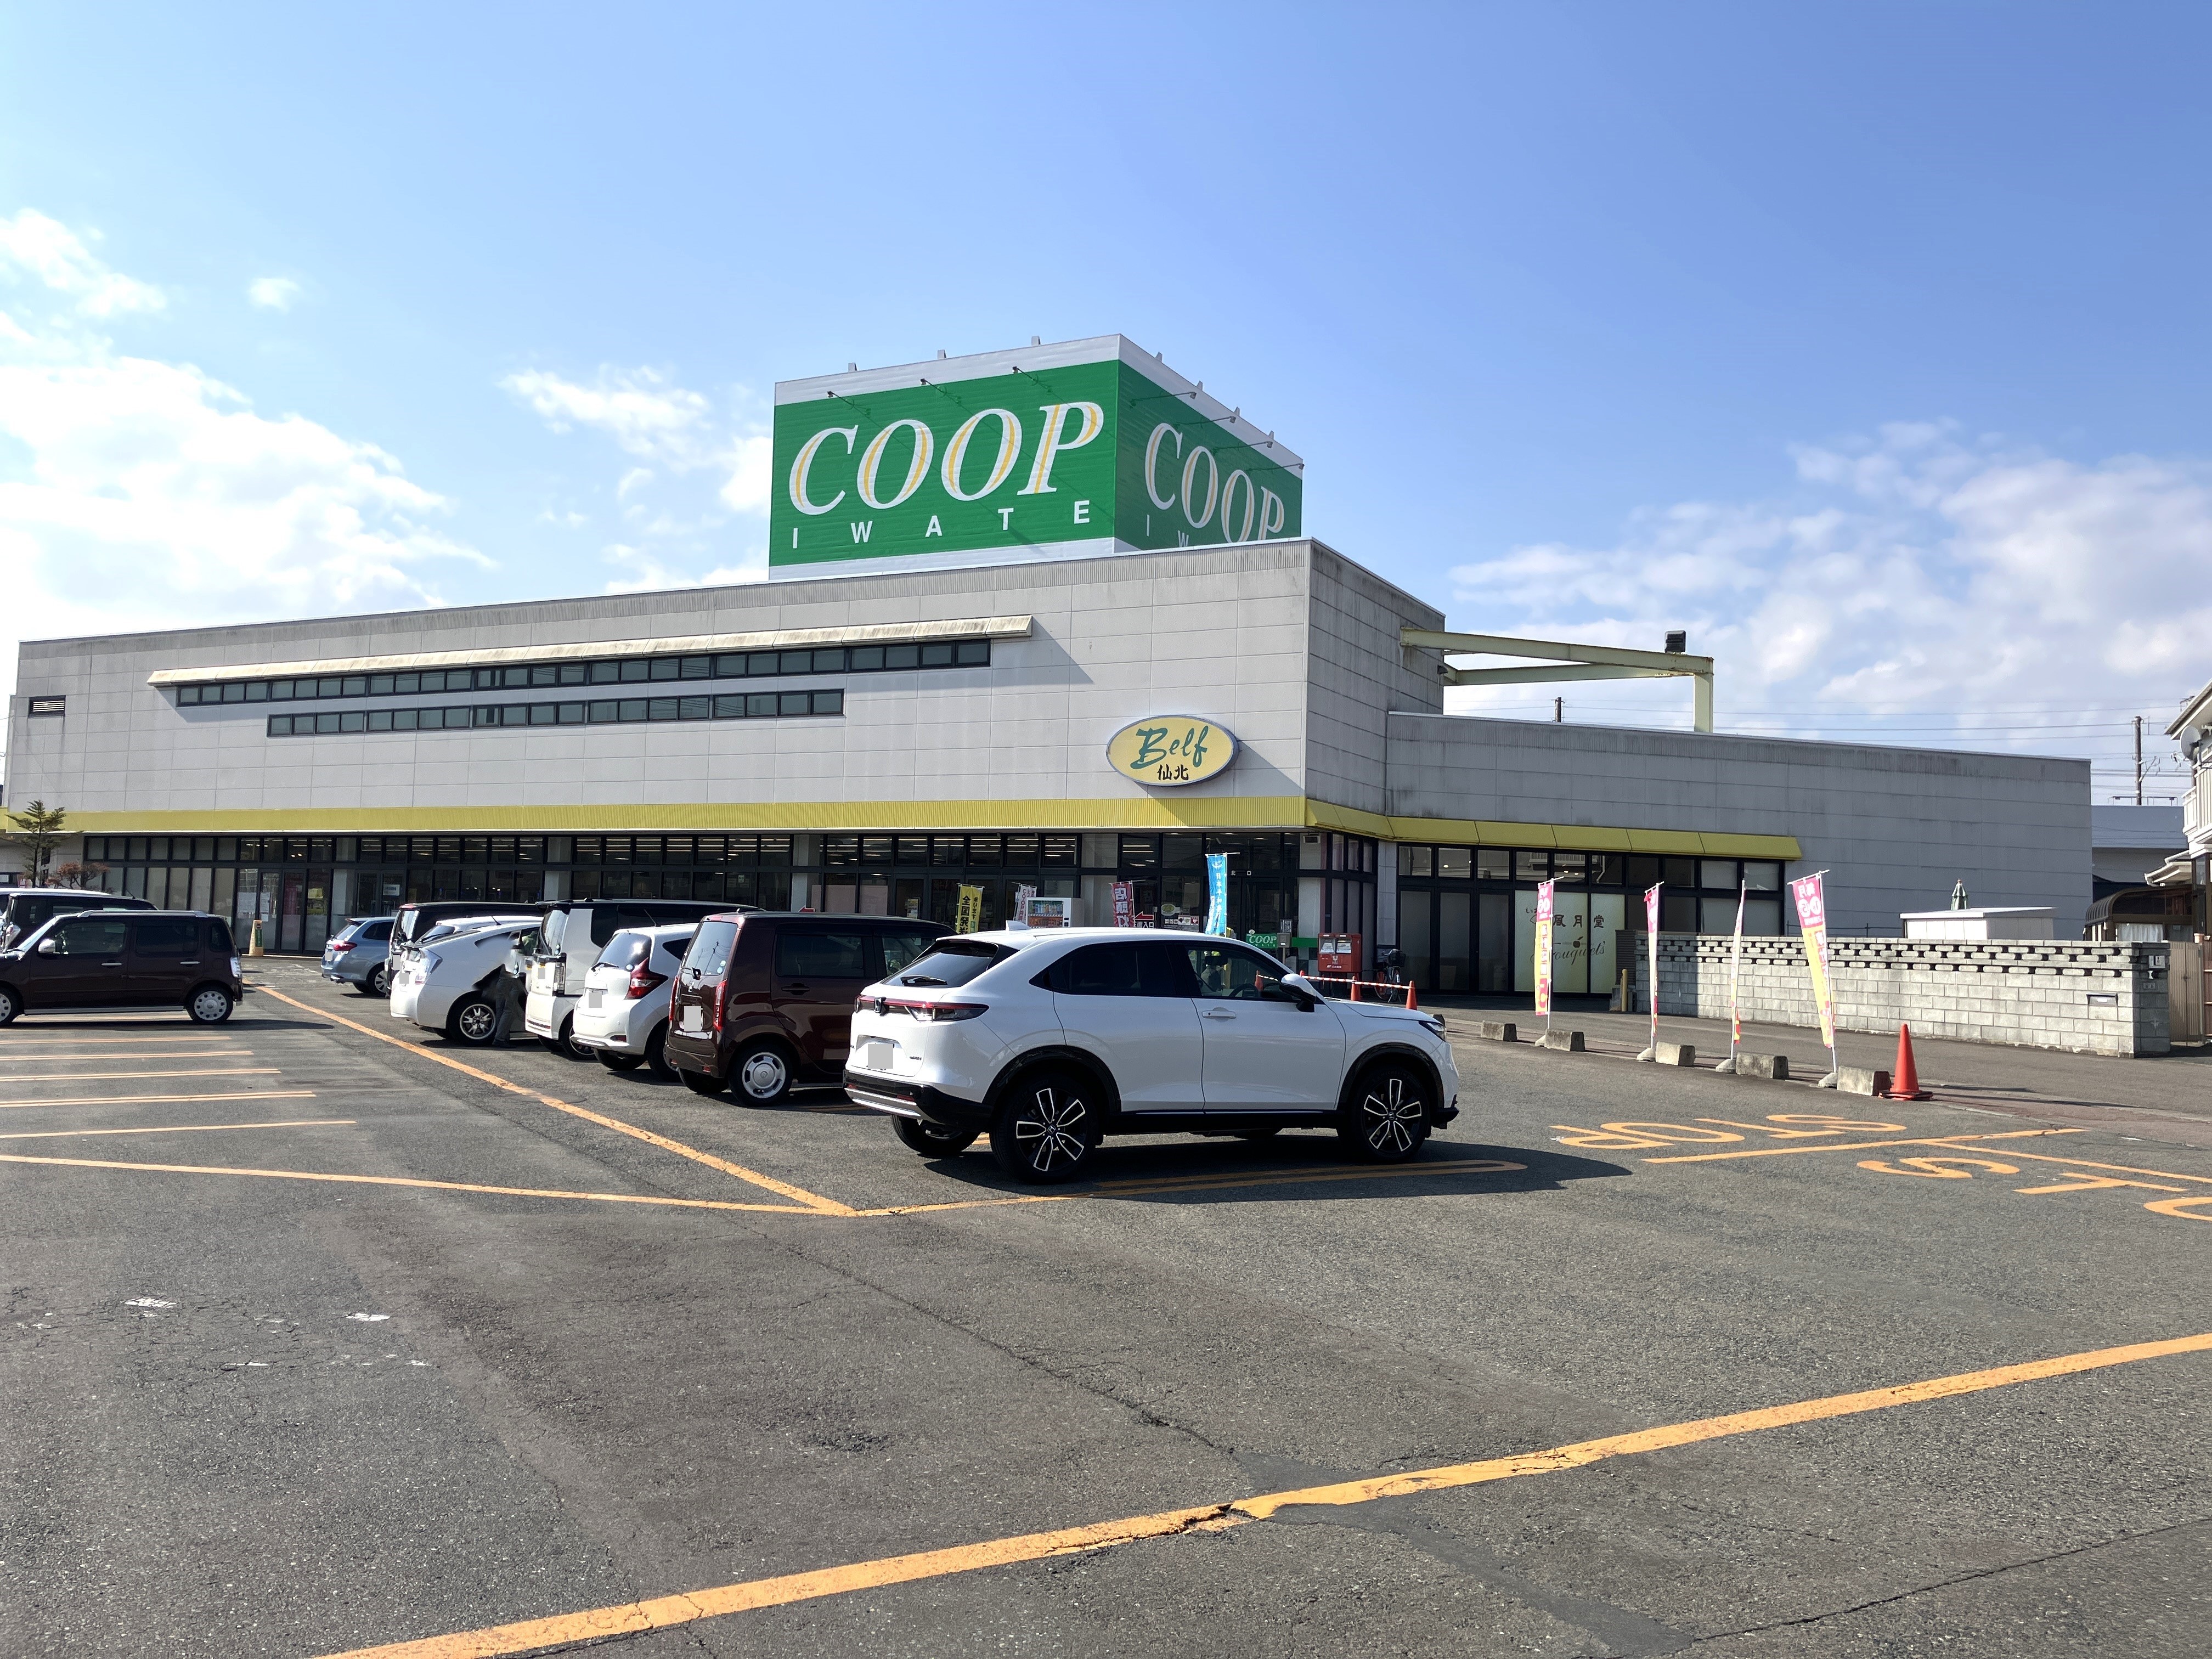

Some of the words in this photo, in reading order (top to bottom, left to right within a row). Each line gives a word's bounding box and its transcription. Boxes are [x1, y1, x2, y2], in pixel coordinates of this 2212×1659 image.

[789, 402, 1104, 515] COOP
[1145, 423, 1284, 543] COOP
[1130, 726, 1209, 770] Belf
[1157, 764, 1189, 781] 仙北
[1553, 915, 1604, 929] 風月堂
[1249, 935, 1277, 944] COOP
